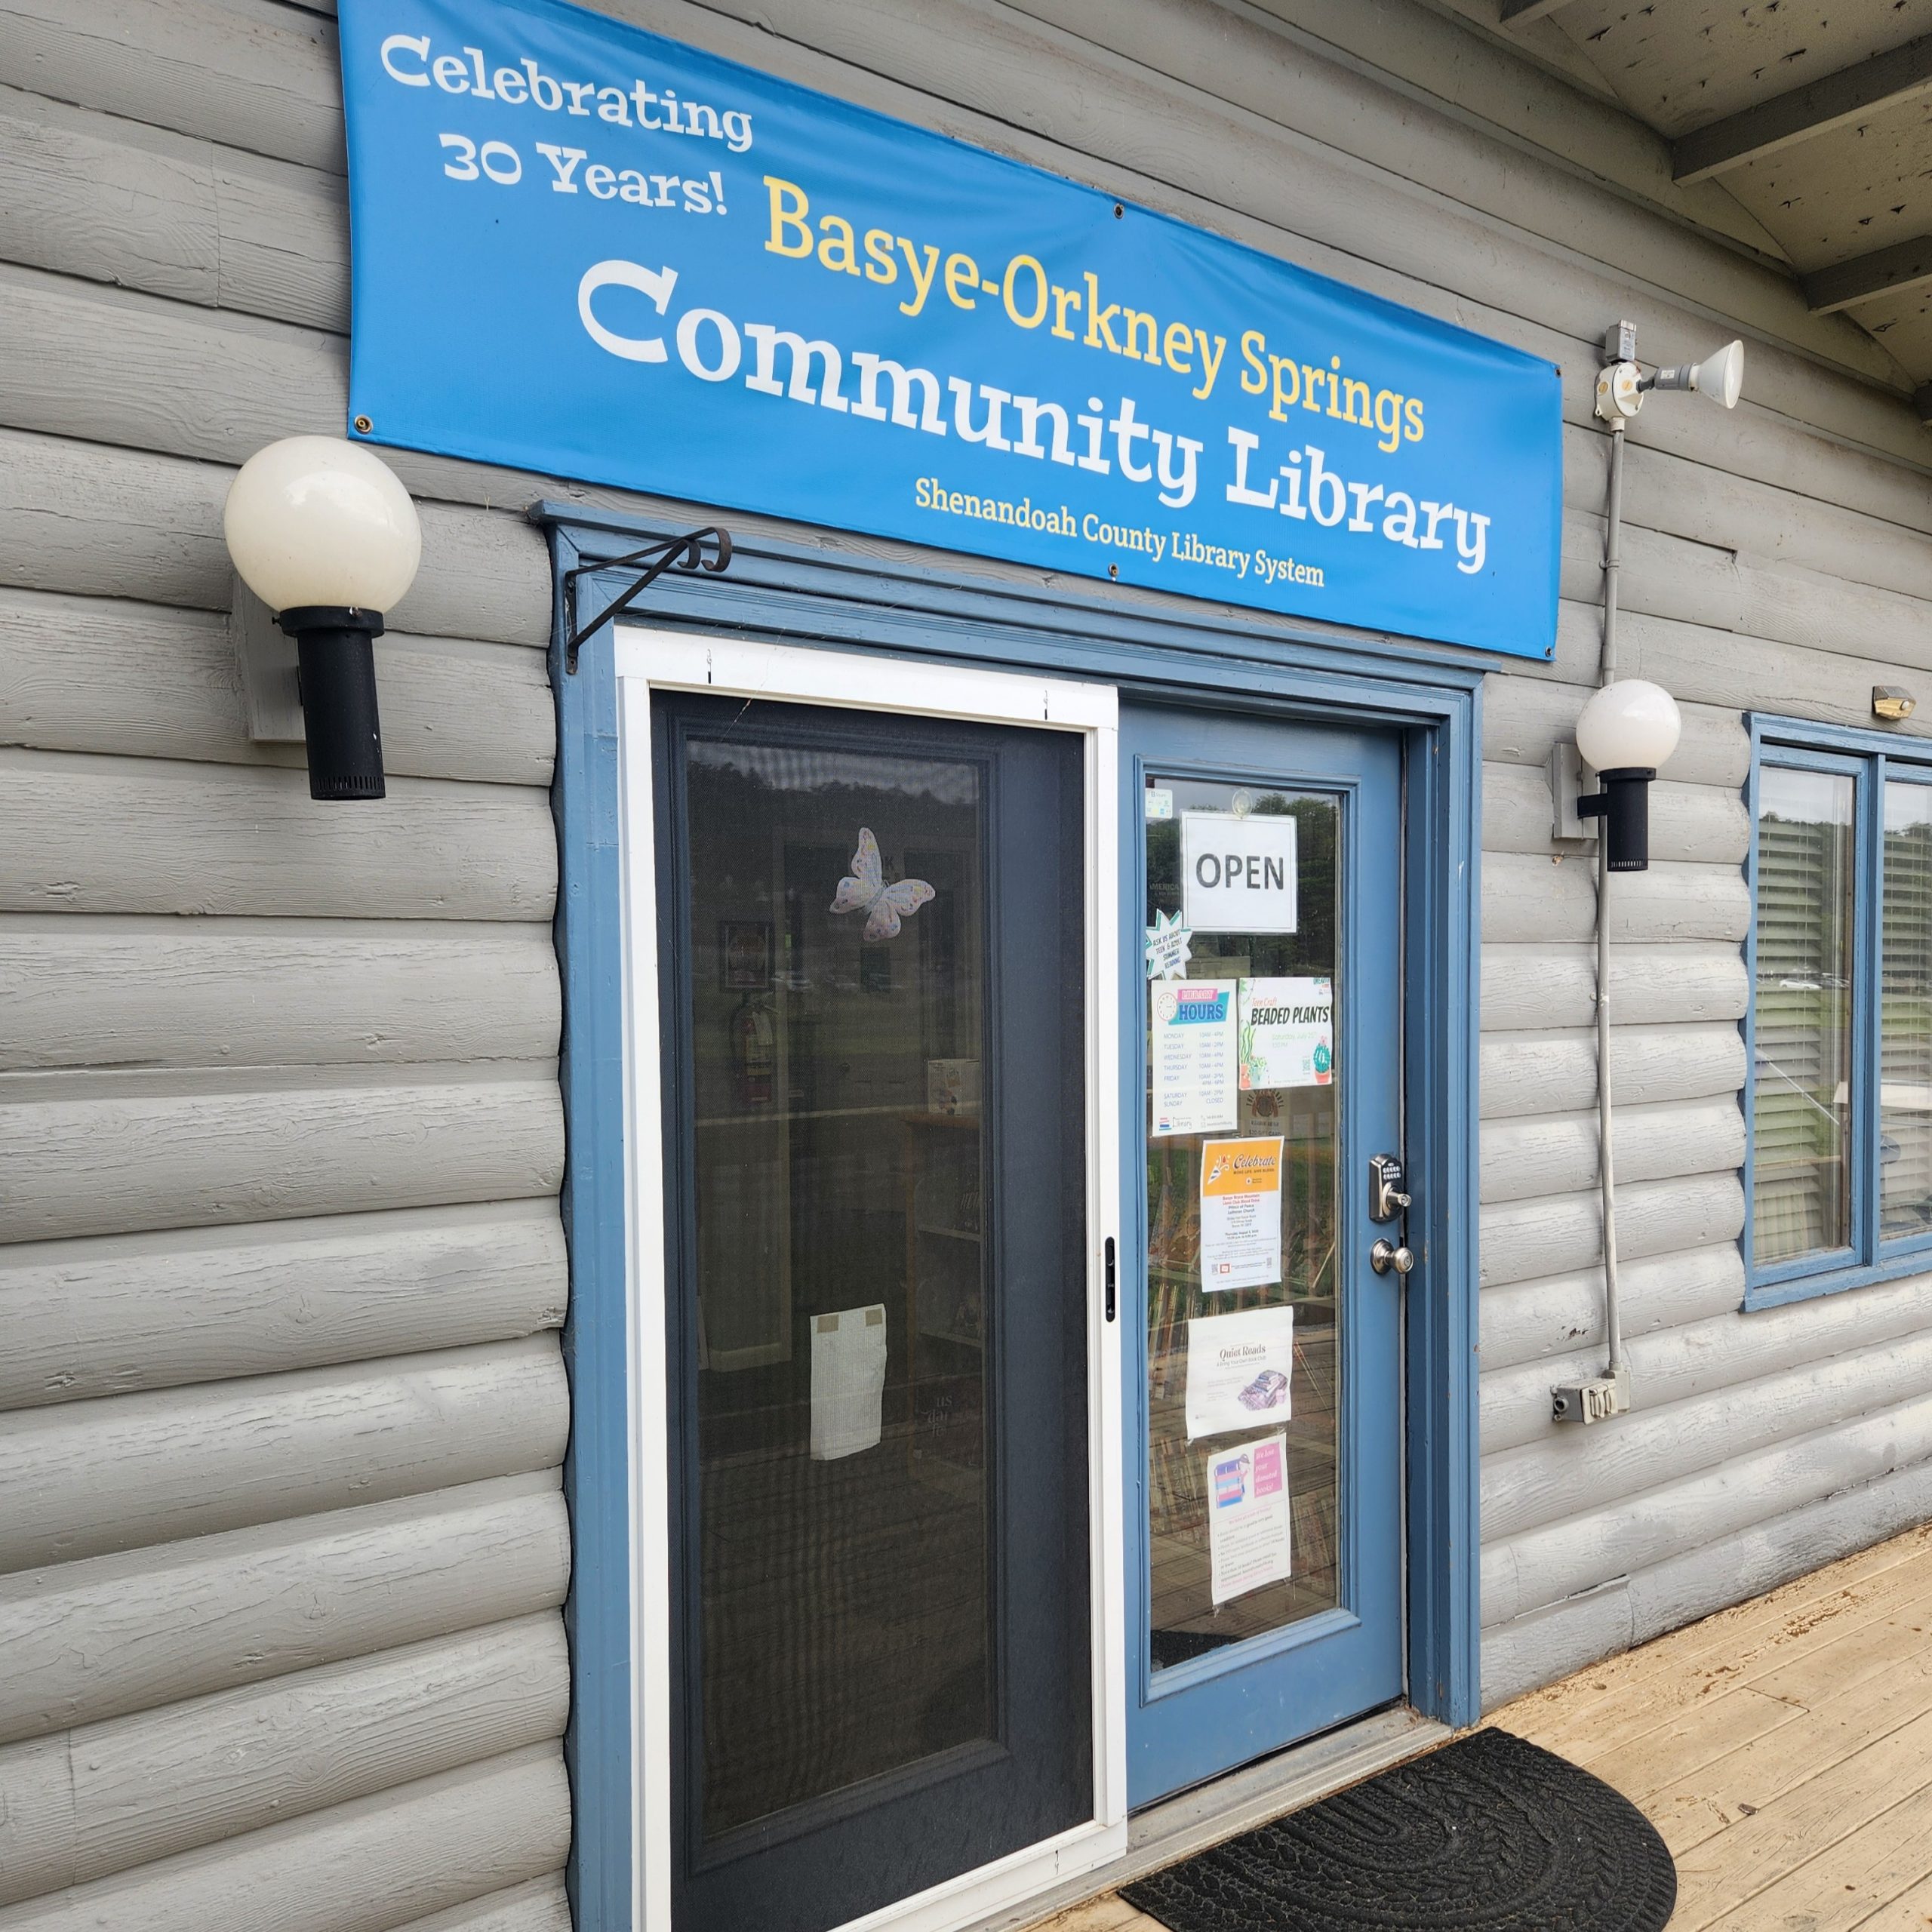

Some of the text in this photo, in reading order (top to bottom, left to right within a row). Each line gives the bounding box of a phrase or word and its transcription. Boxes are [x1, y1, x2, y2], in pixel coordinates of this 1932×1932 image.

[380, 34, 752, 152] Celebrating
[438, 134, 728, 215] 30 Years!
[763, 176, 1424, 453] Basye-Orkney Springs
[578, 260, 1491, 574] Community Library
[915, 477, 1324, 587] Shenandoah County Library System
[1196, 853, 1284, 890] OPEN
[1153, 937, 1162, 946] ASK
[1181, 990, 1214, 999] LIBRARY
[1179, 1003, 1223, 1021] HOURS
[1251, 1006, 1329, 1026] BEADED PLANTS
[1233, 1154, 1276, 1169] Celebrate
[1220, 1348, 1241, 1361] Quiet
[1242, 1343, 1266, 1355] Reads
